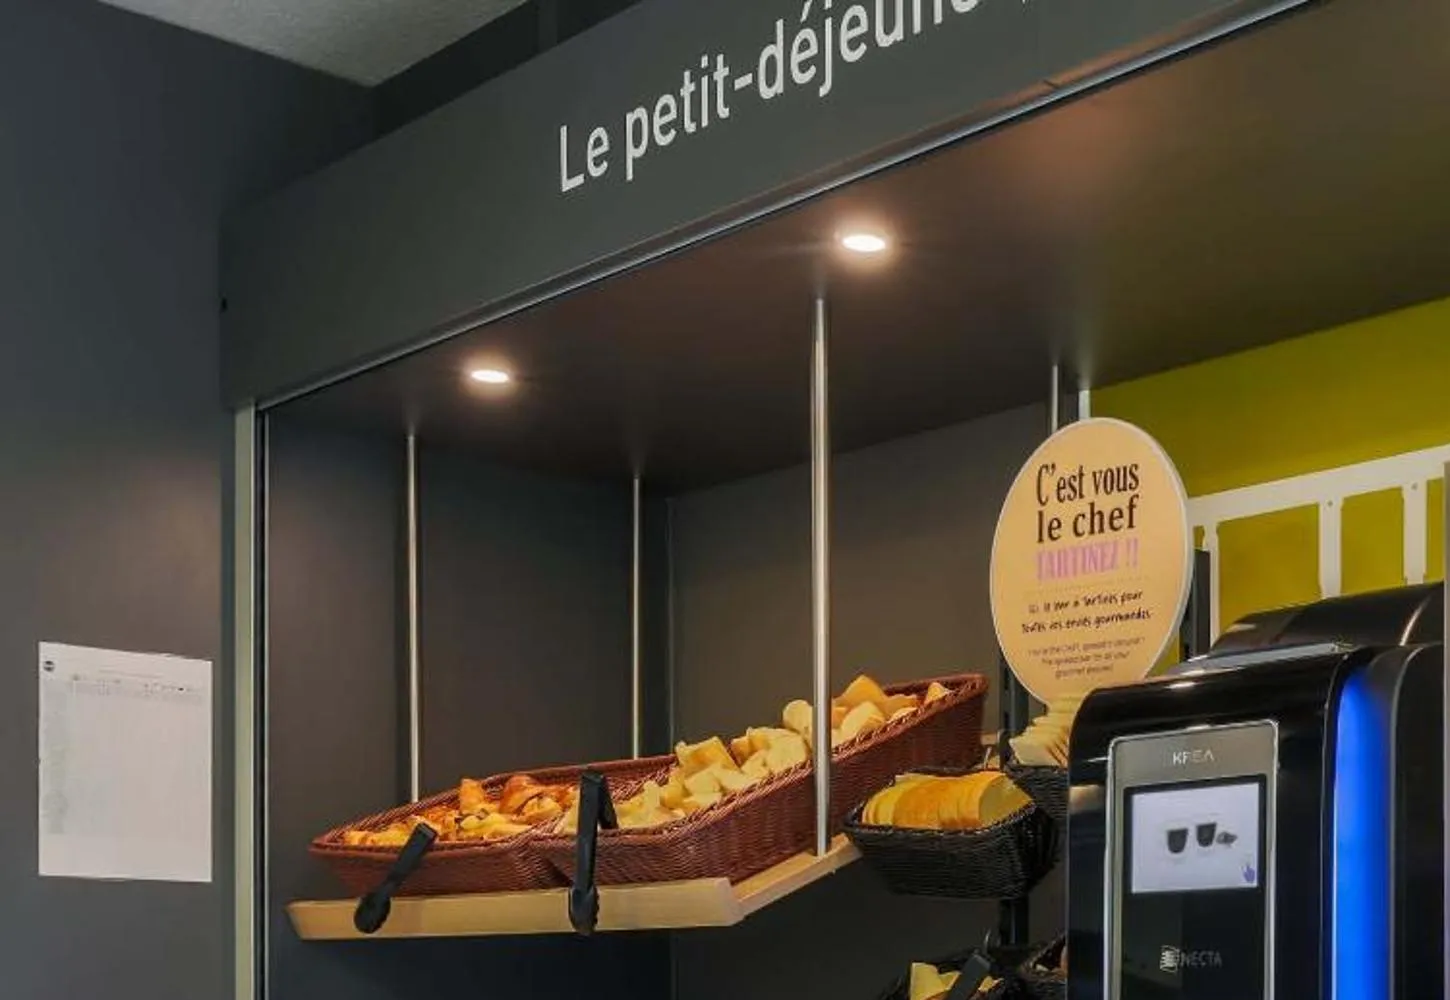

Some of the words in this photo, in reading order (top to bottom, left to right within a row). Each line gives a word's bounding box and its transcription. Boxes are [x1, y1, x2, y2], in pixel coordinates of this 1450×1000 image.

[560, 124, 610, 193] Le
[626, 0, 980, 180] petit-déjeun
[1036, 463, 1085, 506] C'est
[1092, 463, 1140, 496] vous
[1036, 510, 1063, 544] le
[1072, 494, 1140, 538] chef
[1181, 949, 1223, 969] NECTA
